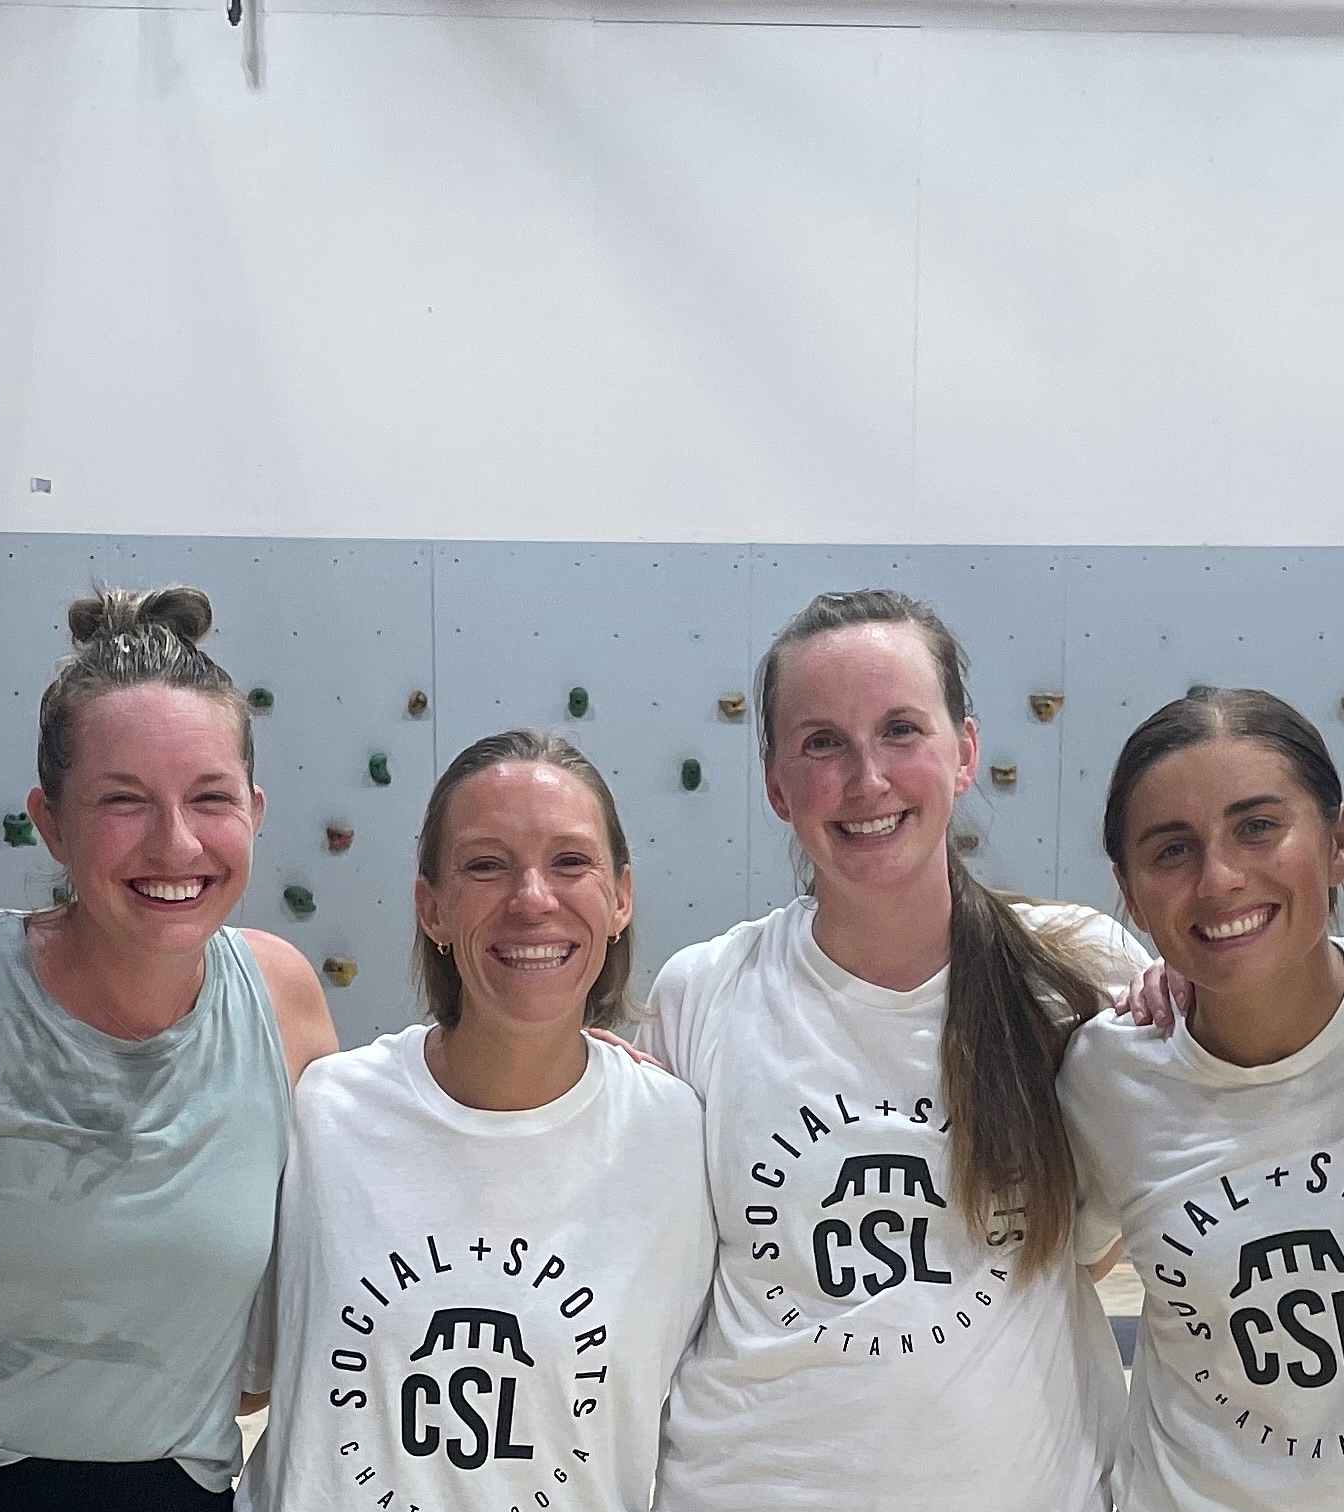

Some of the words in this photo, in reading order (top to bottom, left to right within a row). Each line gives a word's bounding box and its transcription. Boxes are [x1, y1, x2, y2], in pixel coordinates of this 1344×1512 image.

[812, 1209, 952, 1298] CSL
[766, 1268, 1008, 1356] CHTTANOOGA
[401, 1366, 535, 1471] CSL
